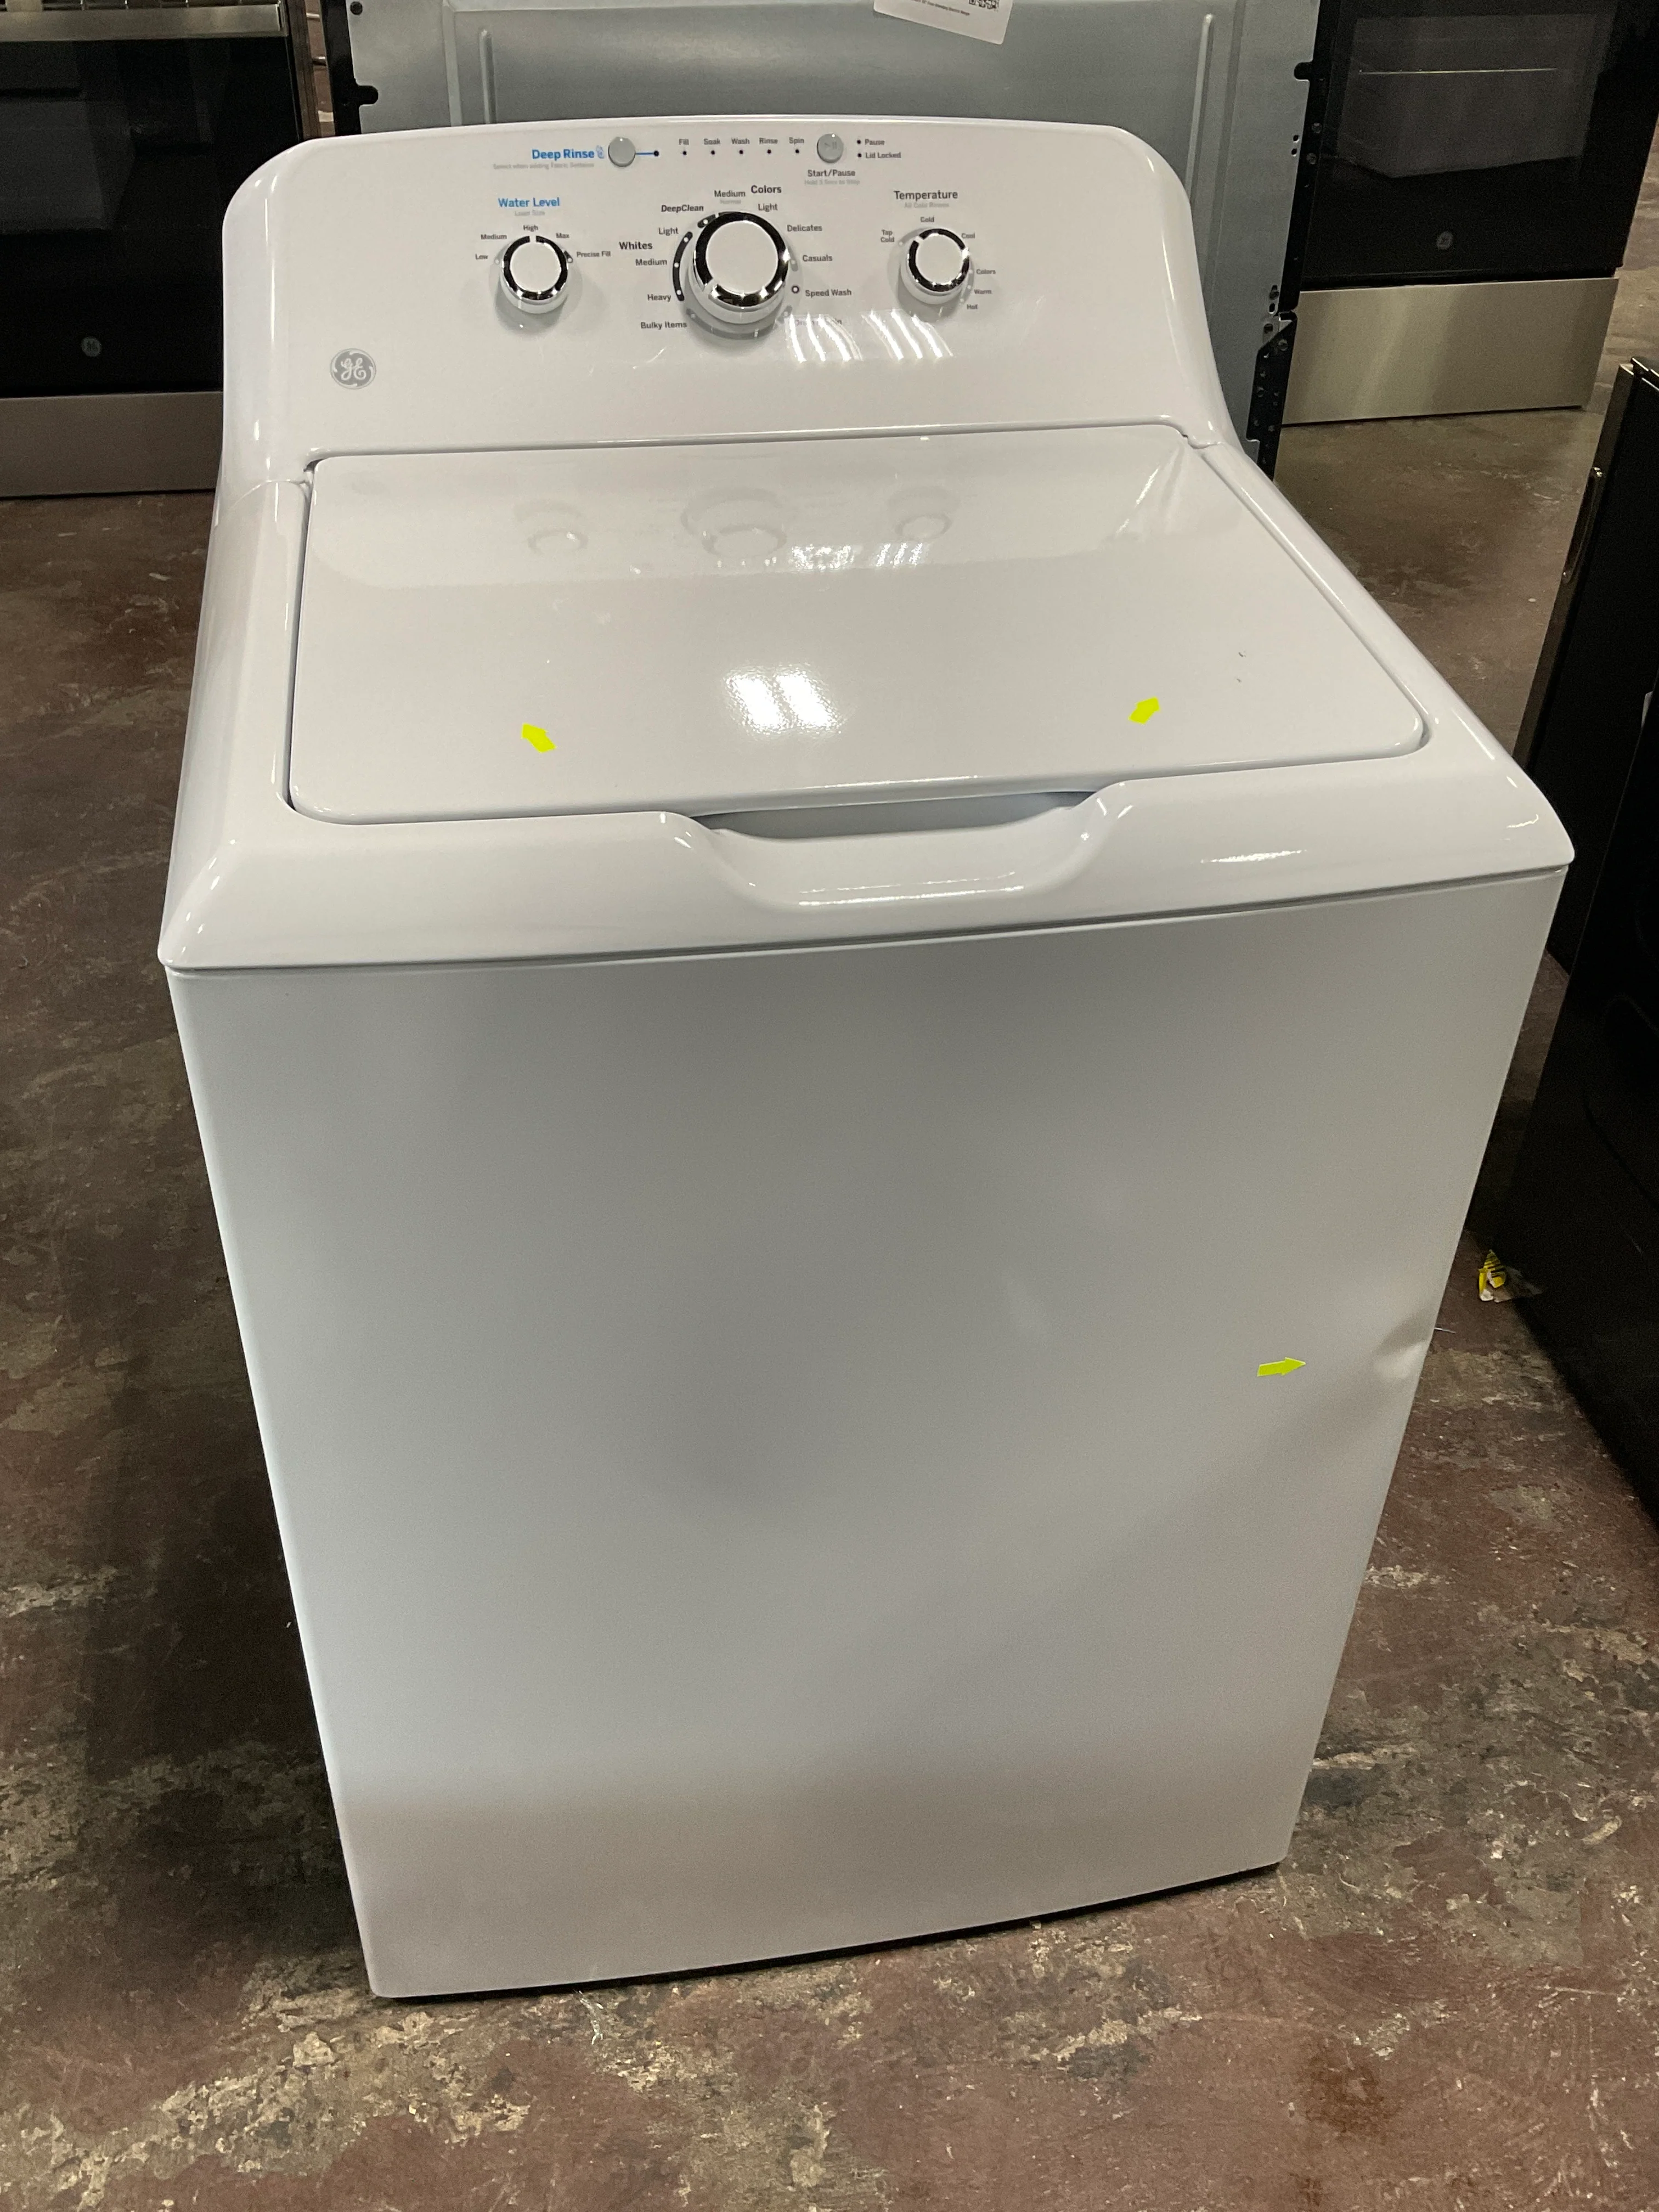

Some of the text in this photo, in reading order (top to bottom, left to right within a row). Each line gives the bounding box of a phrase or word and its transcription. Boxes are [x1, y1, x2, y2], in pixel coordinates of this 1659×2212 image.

[788, 137, 805, 145] Spin
[532, 149, 595, 161] Deep Rinse
[807, 169, 856, 177] Start/Pause
[751, 185, 782, 194] Colors
[893, 190, 958, 202] Temperature
[498, 196, 560, 207] Water Level
[661, 204, 704, 213] DeepClean
[758, 203, 778, 212] Light
[658, 227, 679, 236] Light
[619, 241, 653, 250] Whites
[802, 254, 833, 262] Casuals
[647, 294, 672, 302] Heavy
[805, 289, 830, 298] Speed
[640, 320, 687, 330] Bulky Items
